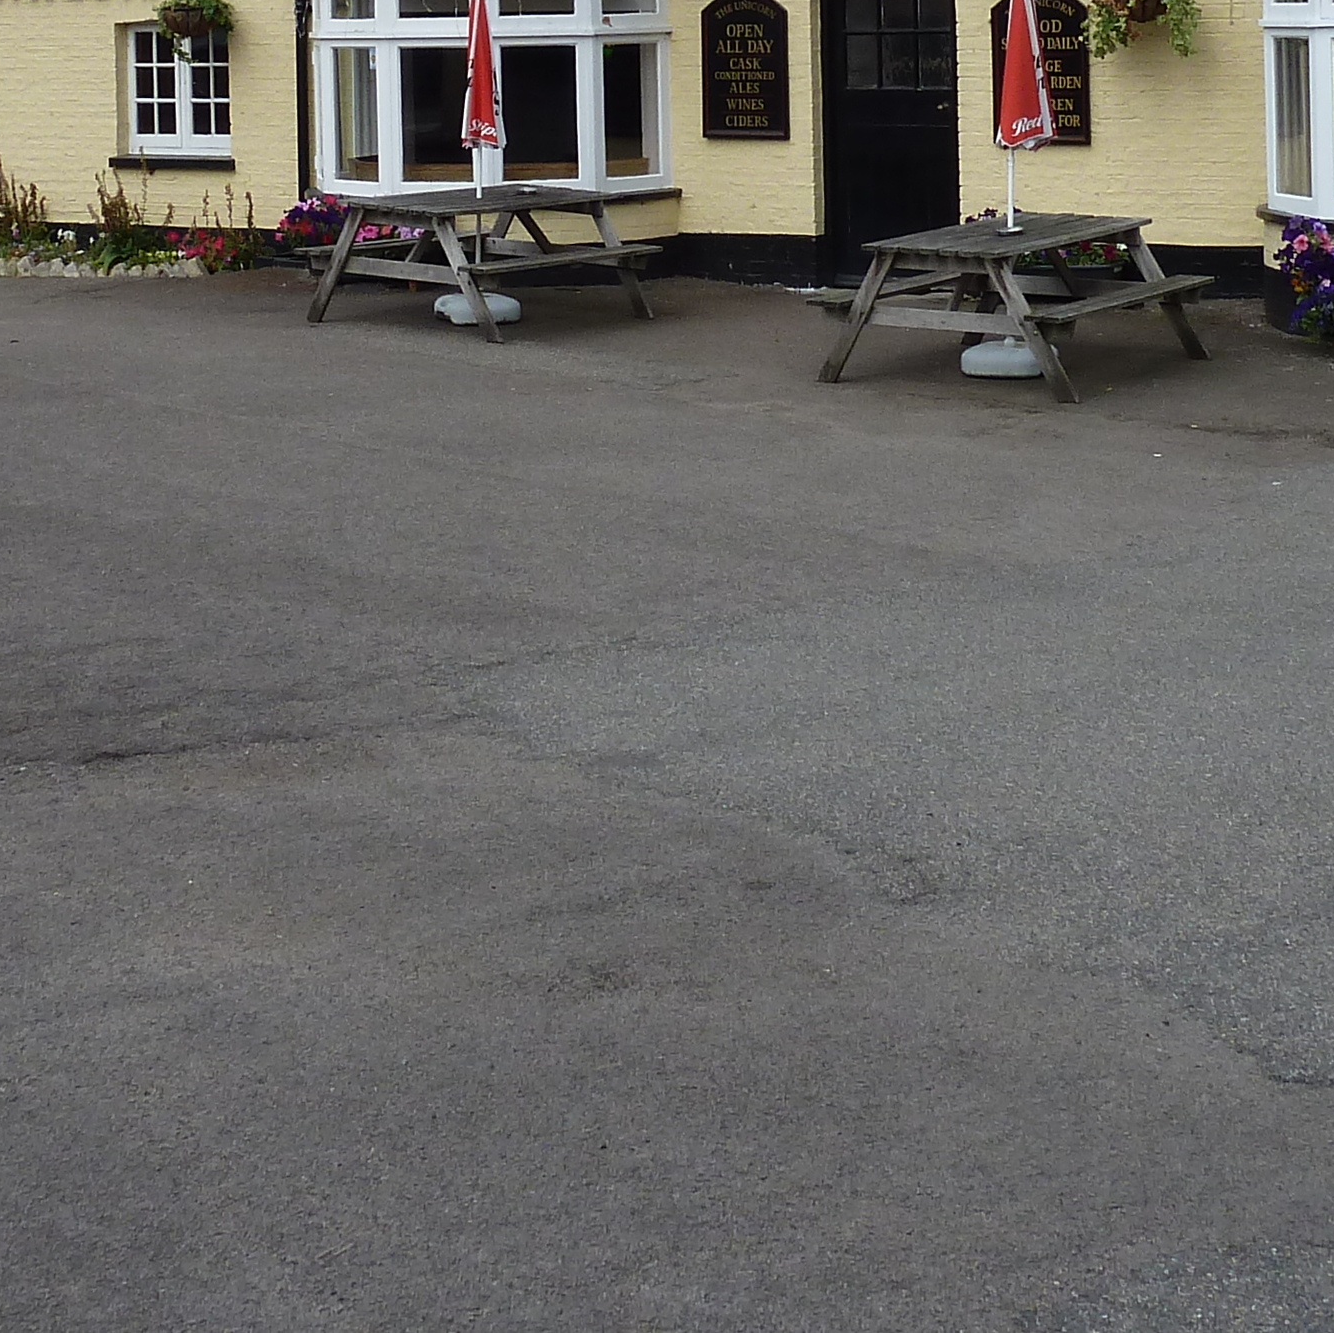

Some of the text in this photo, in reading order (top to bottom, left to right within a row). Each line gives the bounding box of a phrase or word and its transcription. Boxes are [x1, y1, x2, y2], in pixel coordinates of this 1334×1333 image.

[715, 0, 777, 19] THE UNICORN
[727, 23, 764, 38] OPEN
[1040, 19, 1062, 33] OD
[716, 39, 774, 54] ALL DAY
[1047, 36, 1080, 50] DAILY
[730, 58, 762, 70] CASK
[714, 71, 775, 80] CONDITIONED
[1050, 75, 1082, 89] RDEN
[730, 82, 760, 94] ALES
[726, 98, 765, 110] WINES
[726, 115, 769, 127] CIDERS
[1011, 115, 1042, 137] Red
[1058, 114, 1081, 127] FOR
